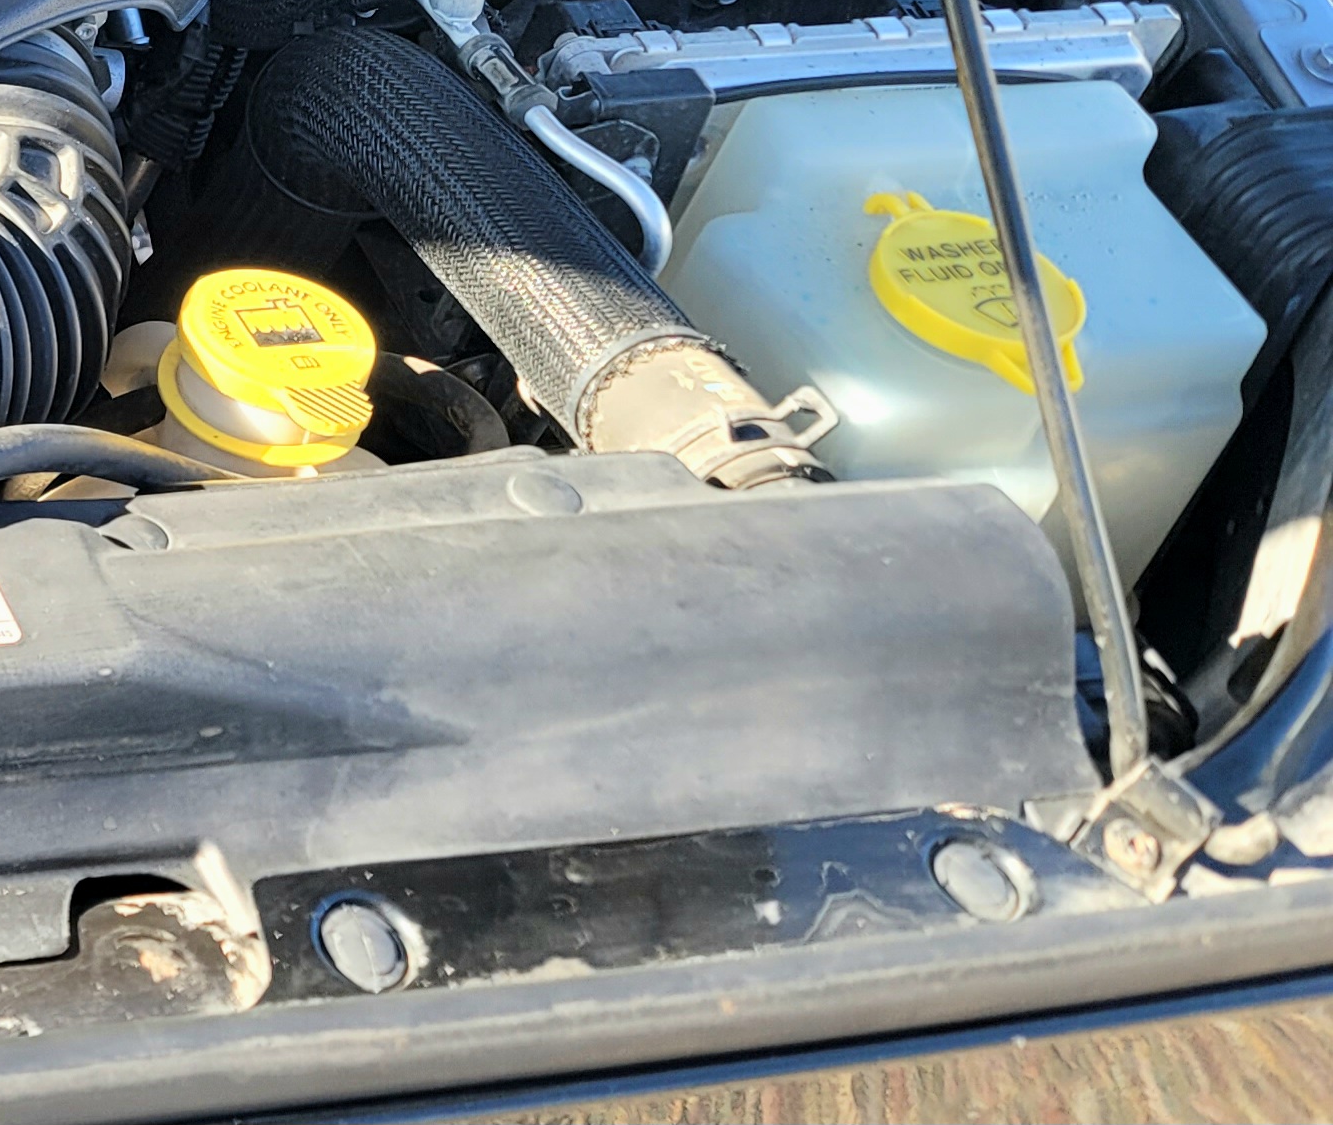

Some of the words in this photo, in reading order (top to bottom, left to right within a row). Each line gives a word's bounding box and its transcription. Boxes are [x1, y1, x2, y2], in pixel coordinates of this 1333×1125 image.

[898, 264, 974, 285] FLUID
[220, 281, 313, 301] COOLANT
[210, 299, 243, 349] ENGINE
[314, 302, 352, 339] ONLY
